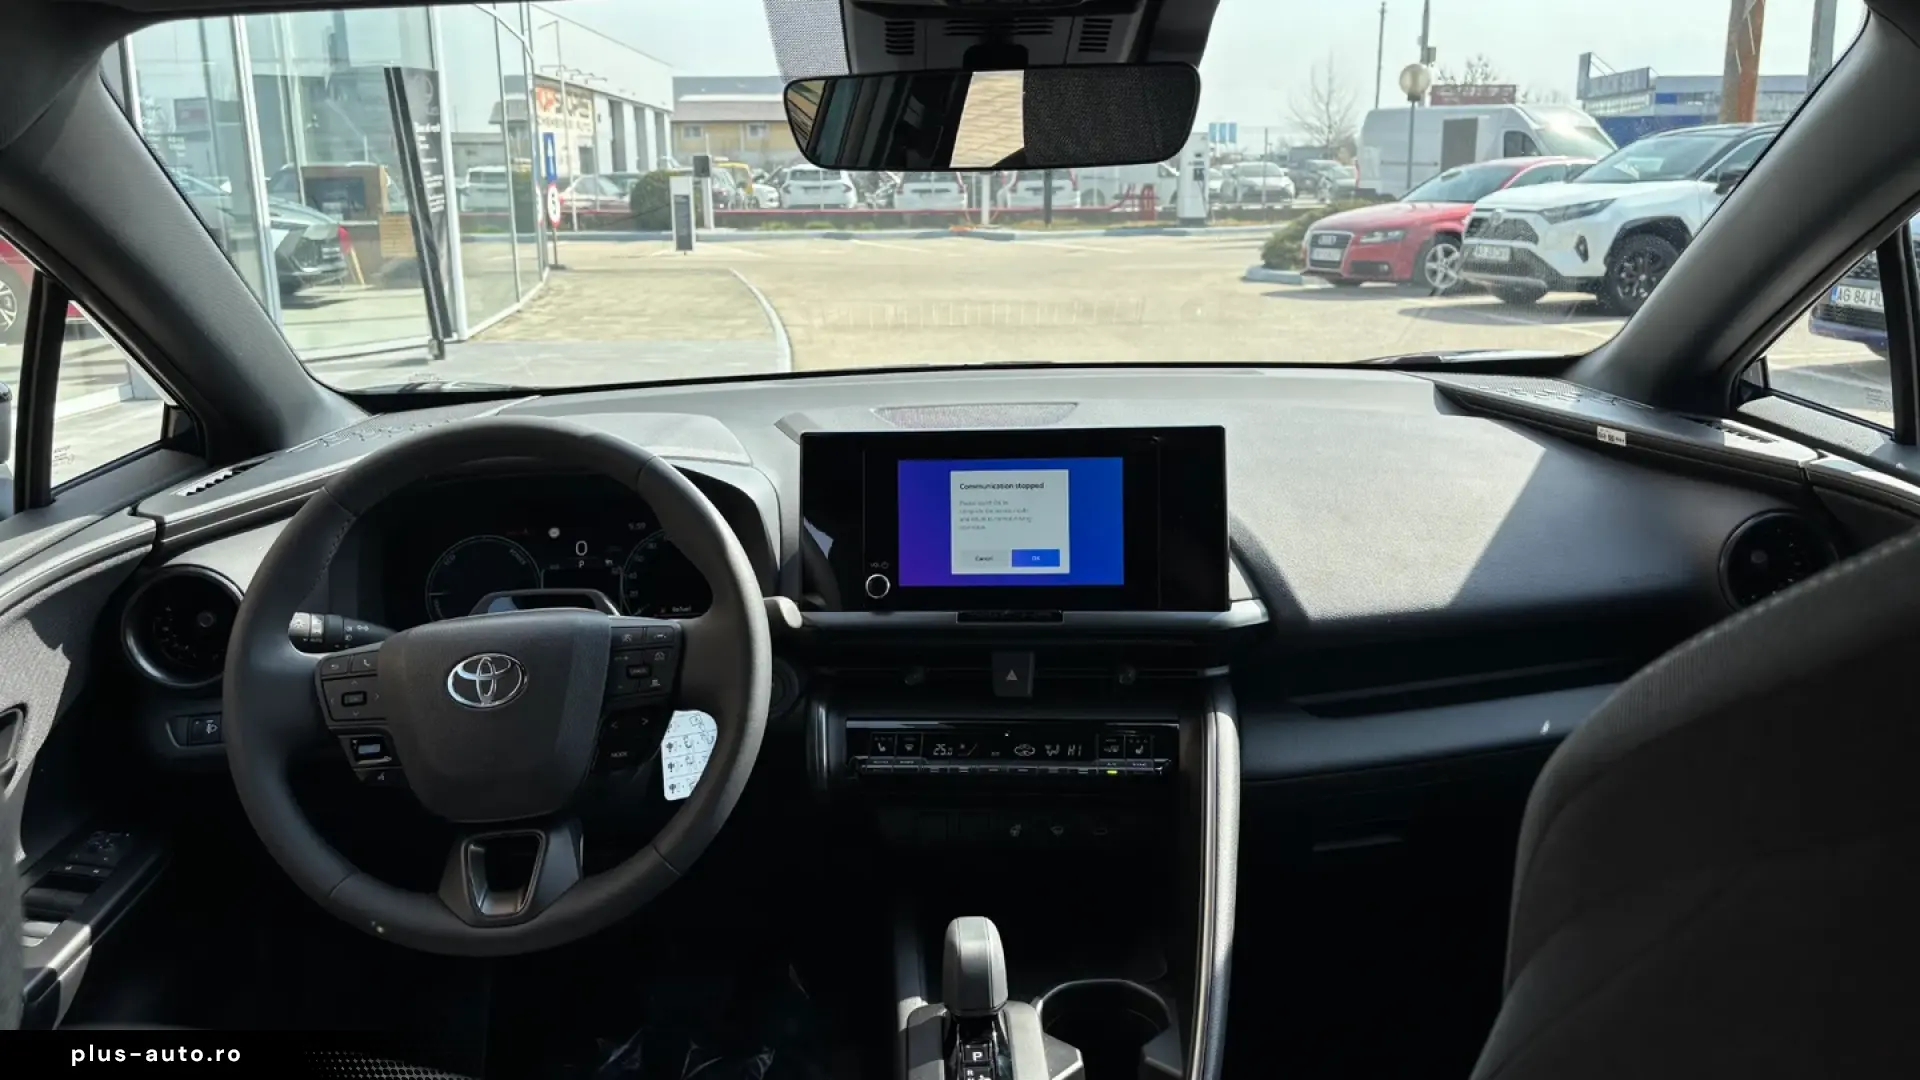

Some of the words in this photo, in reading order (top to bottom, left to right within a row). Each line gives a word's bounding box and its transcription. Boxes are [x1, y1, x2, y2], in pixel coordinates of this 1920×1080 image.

[1015, 482, 1045, 491] stopped
[575, 540, 588, 556] 0
[972, 1051, 983, 1062] P
